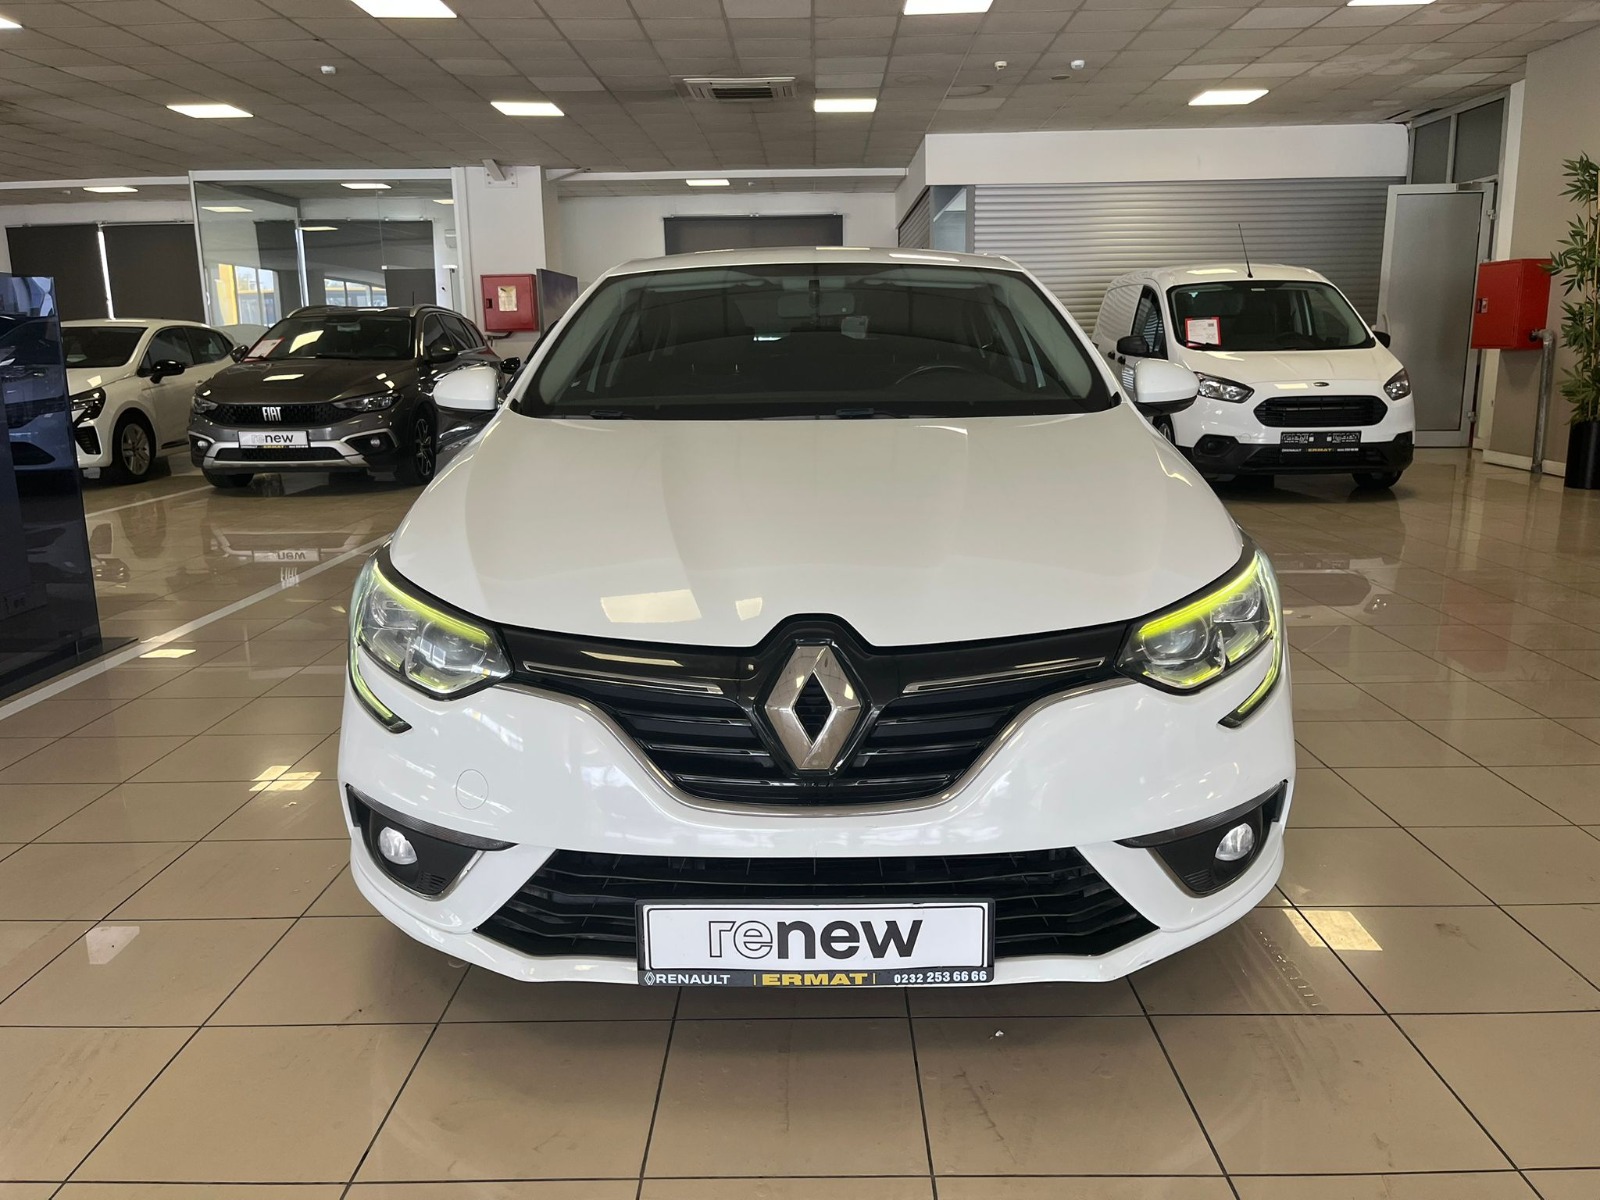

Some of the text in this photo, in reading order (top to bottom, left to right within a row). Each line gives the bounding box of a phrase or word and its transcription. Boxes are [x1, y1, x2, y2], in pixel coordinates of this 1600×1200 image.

[262, 406, 282, 421] FIAT
[708, 919, 924, 959] renew
[656, 970, 987, 986] RENAULT ERMAT 0232 253 66 66
